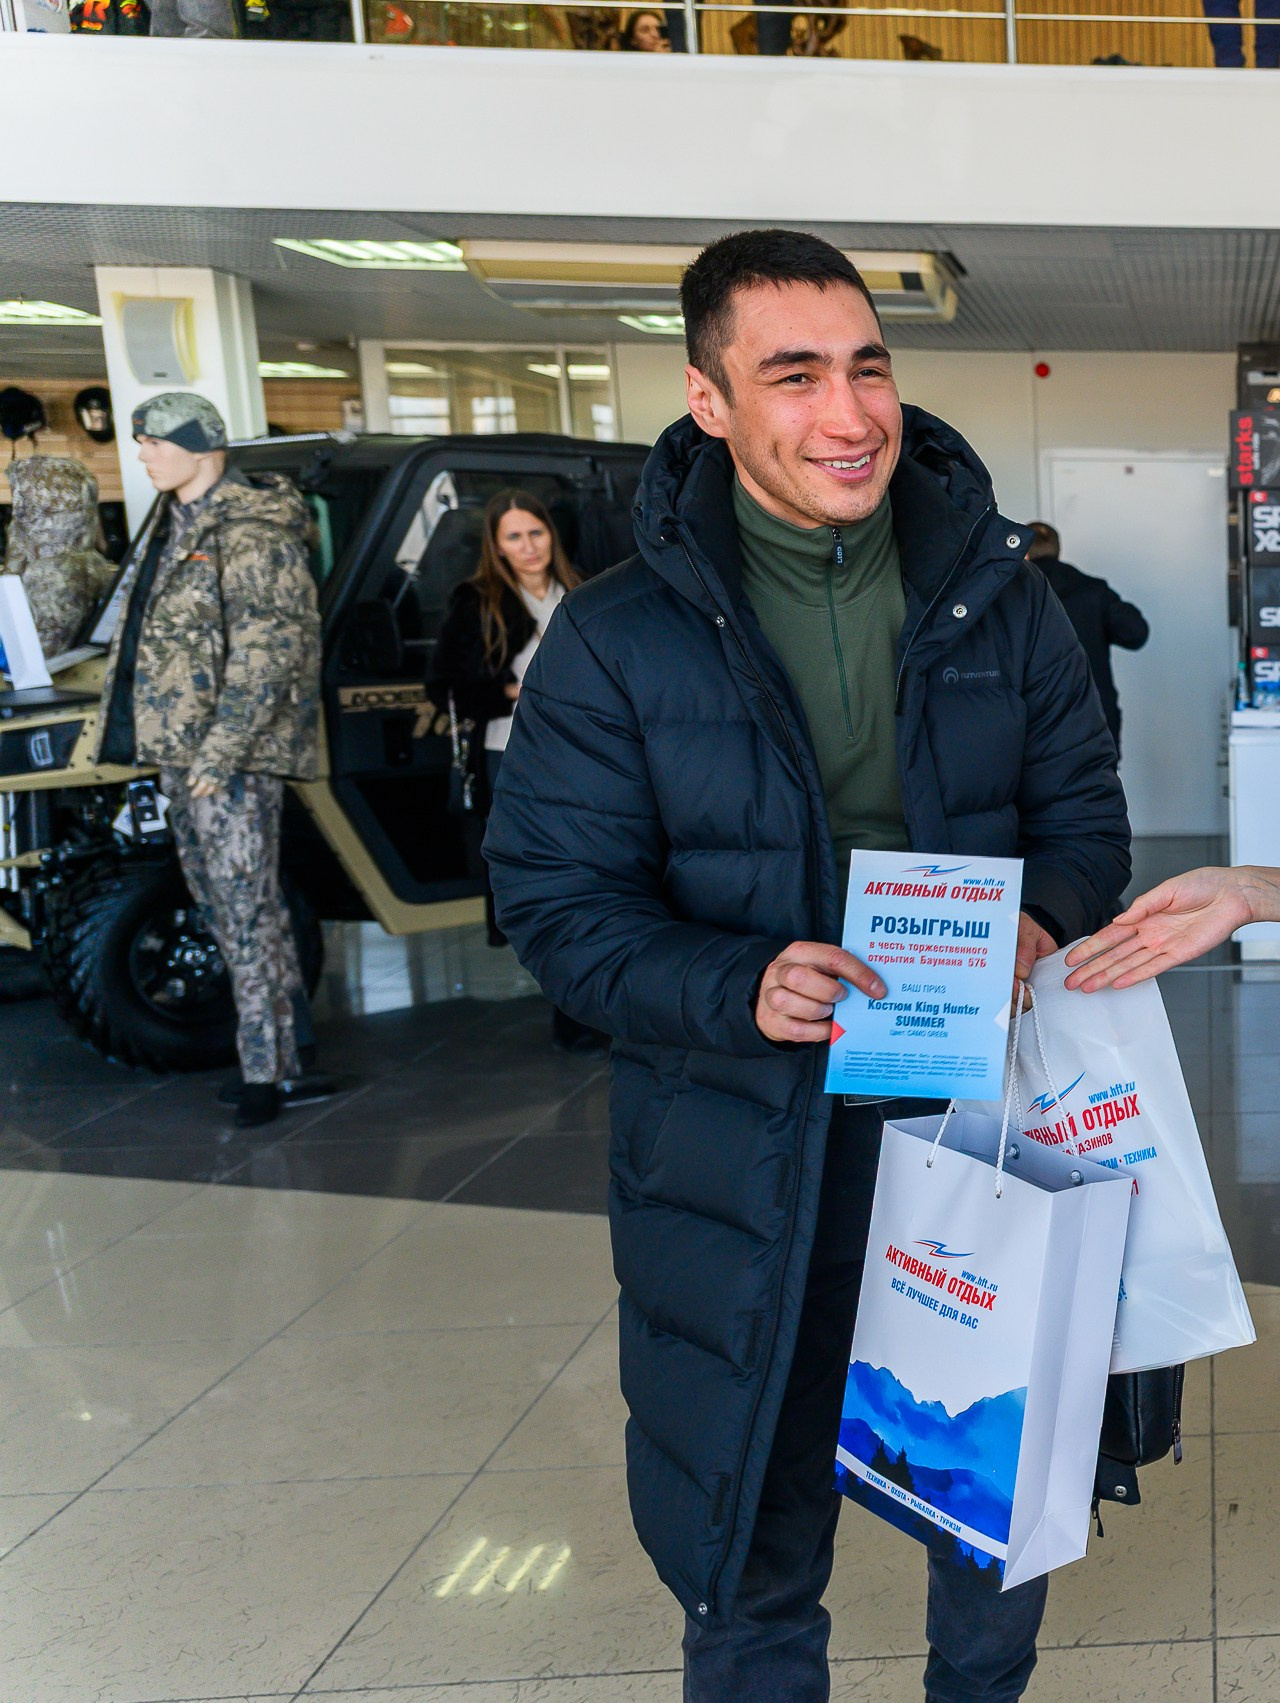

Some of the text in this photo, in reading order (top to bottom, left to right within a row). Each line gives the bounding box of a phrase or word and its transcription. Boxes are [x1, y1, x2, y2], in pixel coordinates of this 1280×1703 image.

[1235, 416, 1254, 485] starks
[864, 881, 1005, 902] АКТИВНЫЙ ОТДЫХ
[963, 877, 1006, 887] www.hft.ru
[870, 915, 991, 939] РОЗЫГРЫШ
[869, 941, 988, 955] в честь торжественного
[868, 953, 915, 964] открытия
[919, 955, 963, 967] Баумана
[901, 983, 947, 994] ВАШ ПРИЗ
[867, 998, 981, 1016] Костюм King Hunter
[895, 1015, 946, 1028] SUMMER
[1088, 1081, 1136, 1104] www.hft.ru
[1082, 1093, 1141, 1131] ОТДЫХ
[1123, 1146, 1158, 1165] ТЕХНИКА
[885, 1244, 997, 1311] АКТИВНЫЙ ОТДЫХ
[960, 1270, 999, 1292] www.hft.ru
[890, 1277, 979, 1330] ВСЁ ЛУЧШЕЕ ДЛЯ ВАС
[865, 1470, 962, 1534] ТЕХНИКА ОХОТА РЫБАЛКА ТУРИЗМ
